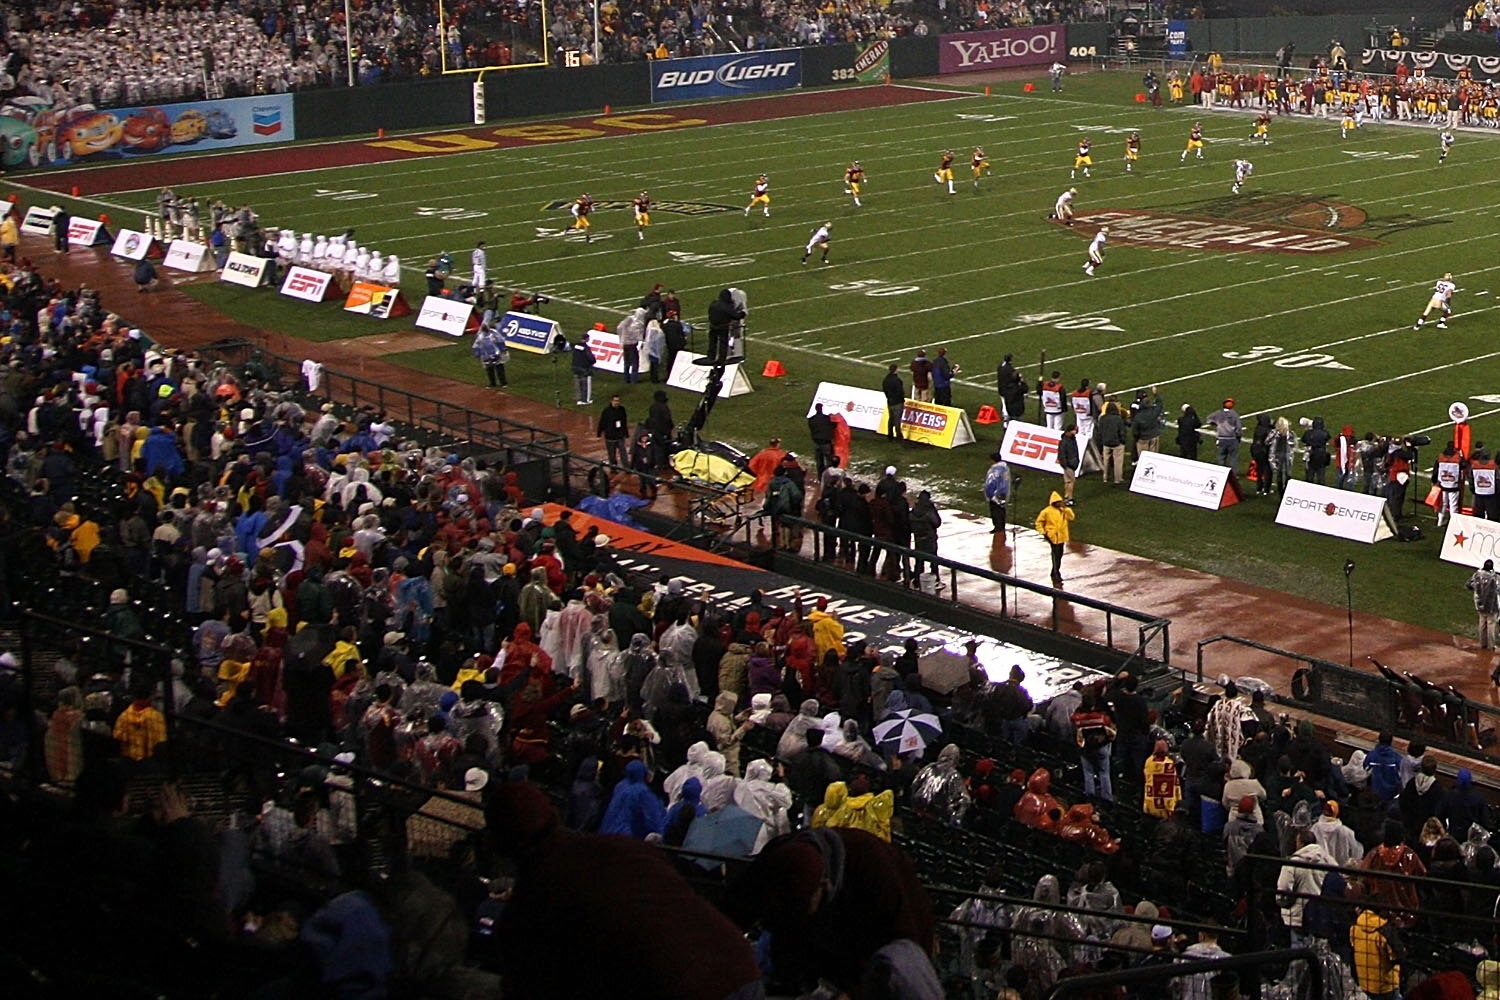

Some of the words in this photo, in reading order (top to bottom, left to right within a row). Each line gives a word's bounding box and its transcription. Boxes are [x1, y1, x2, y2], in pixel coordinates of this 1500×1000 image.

[856, 40, 888, 71] EMERALD
[950, 31, 1056, 67] YAHOO!
[1069, 46, 1096, 57] 404
[657, 69, 716, 89] BUD
[724, 60, 796, 82] LIGHT
[832, 68, 855, 80] 382
[365, 113, 708, 153] USC
[288, 273, 325, 296] ESPN
[1223, 345, 1334, 368] 30
[901, 409, 942, 427] LAYERS
[1010, 430, 1061, 464] ESP
[763, 584, 889, 624] HOME
